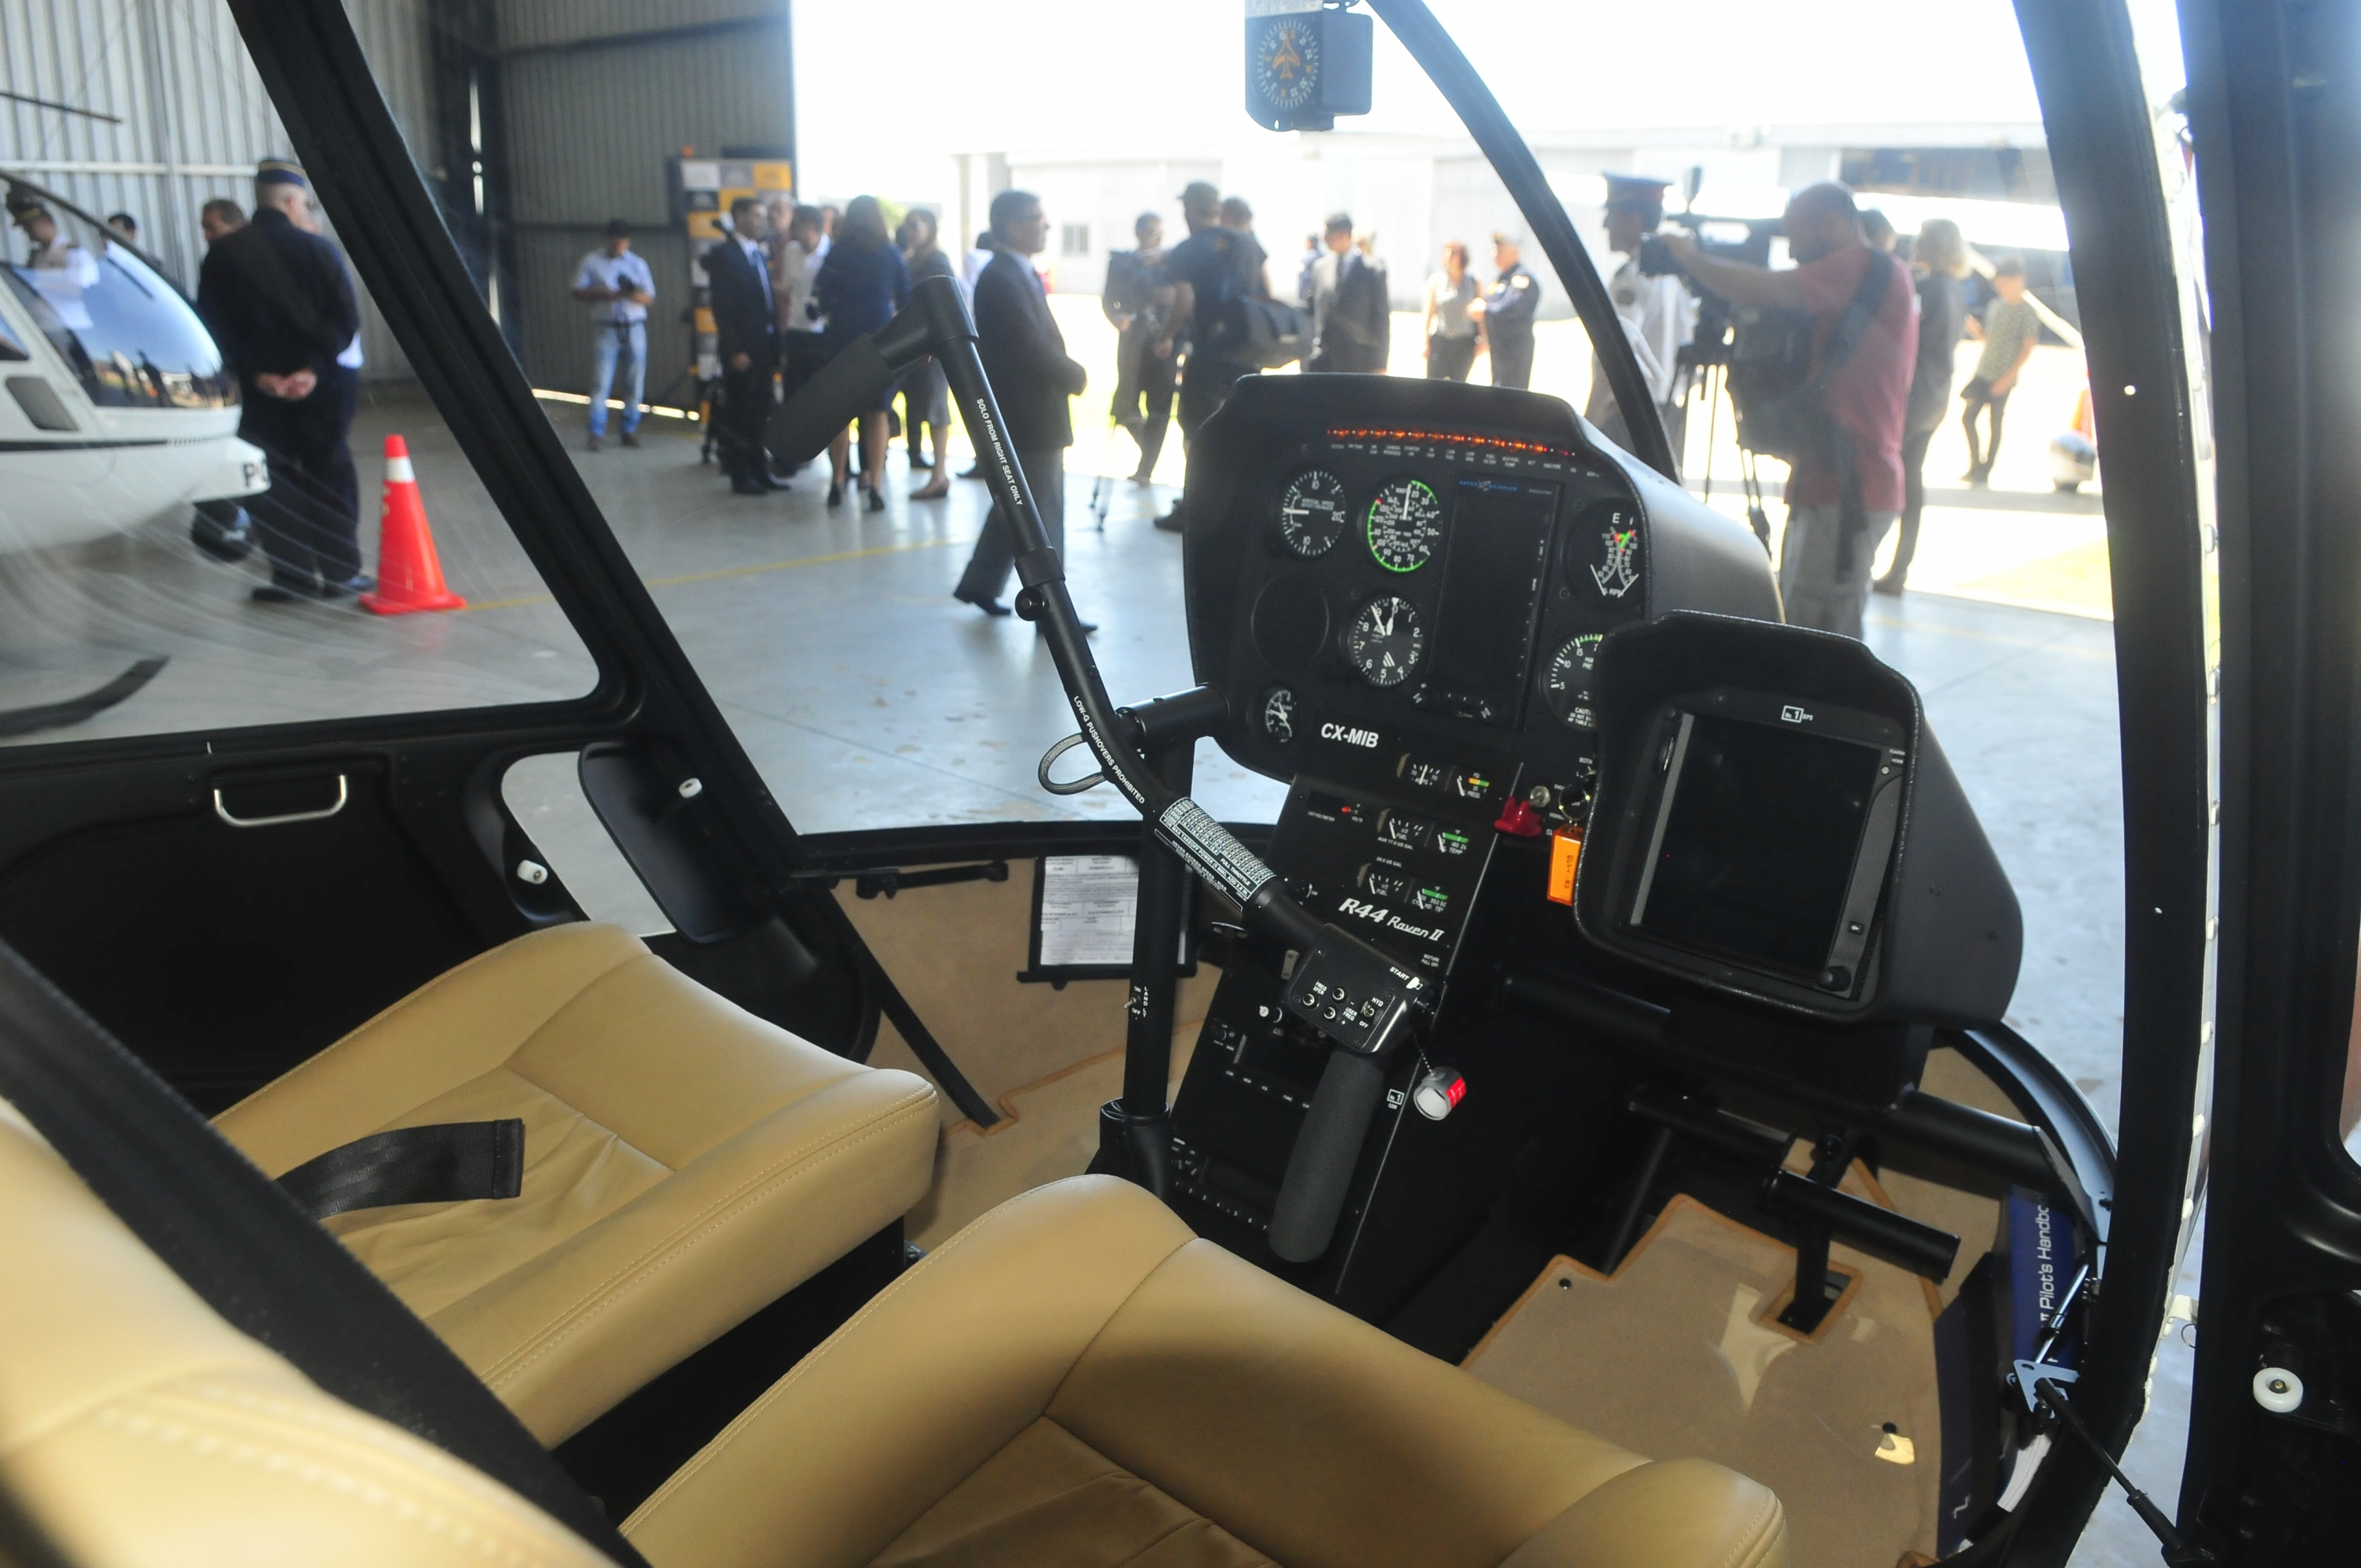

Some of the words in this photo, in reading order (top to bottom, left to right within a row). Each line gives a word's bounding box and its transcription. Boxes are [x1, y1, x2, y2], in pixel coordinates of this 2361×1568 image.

[976, 397, 989, 419] SOLO
[984, 419, 998, 441] FROM
[992, 441, 1007, 465] RIGHT
[1001, 463, 1015, 485] SEAT
[1009, 484, 1023, 506] ONLY
[1612, 512, 1621, 524] E
[1362, 622, 1369, 632] 8
[1413, 627, 1421, 637] 2
[1359, 641, 1365, 651] 7
[1365, 659, 1373, 669] 6
[1409, 654, 1416, 664] 3
[1564, 660, 1571, 669] 10
[1380, 669, 1387, 678] 5
[1560, 681, 1565, 690] 5
[1794, 710, 1800, 720] 1
[1321, 723, 1379, 747] CX-MIB
[1073, 695, 1090, 721] LOW-G
[1085, 721, 1114, 766] PUSHOVERS
[1111, 764, 1145, 803] PROHIBITED
[1162, 818, 1172, 827] FOR
[1171, 825, 1181, 835] MAX
[1180, 833, 1199, 851] TAKEOFF
[1197, 849, 1214, 864] POWER
[1226, 875, 1236, 885] ADD
[1220, 858, 1232, 869] FULL
[1229, 866, 1251, 886] THROTTLE
[1339, 898, 1389, 923] R44
[1387, 916, 1429, 938] Raven
[1428, 928, 1445, 942] II
[1390, 966, 1410, 981] START
[1313, 986, 1325, 995] XFER
[1315, 981, 1328, 991] FREQ
[1372, 997, 1384, 1007] HYD
[1343, 1011, 1355, 1021] FREQ
[1345, 1007, 1358, 1017] USER
[2038, 1264, 2055, 1310] Pilot's
